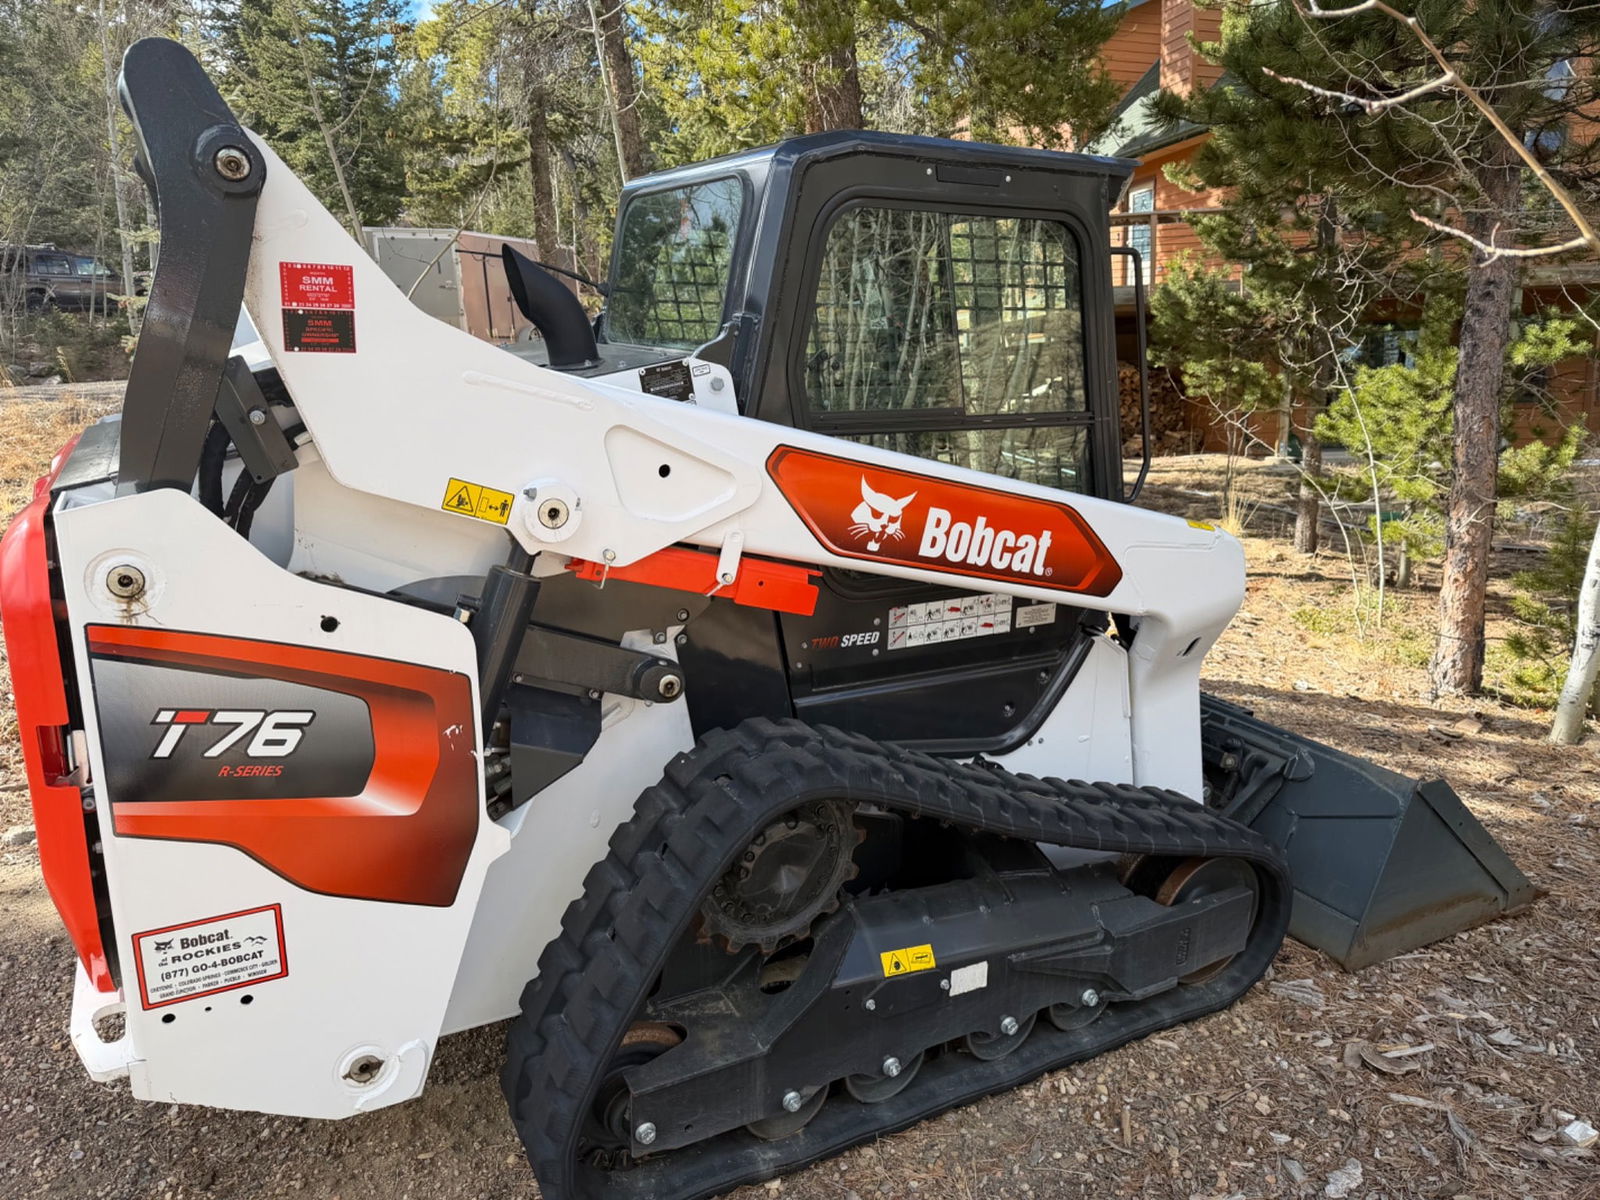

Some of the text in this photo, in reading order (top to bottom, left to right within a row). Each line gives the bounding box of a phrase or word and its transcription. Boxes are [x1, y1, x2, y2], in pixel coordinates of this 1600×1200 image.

[299, 284, 338, 293] RENTAL
[302, 275, 333, 285] SMM
[918, 506, 1052, 577] Bobcat
[811, 631, 880, 648] TWO SPEED
[151, 709, 315, 758] T76
[218, 765, 284, 777] R-SERIES
[180, 929, 230, 950] Bobcat
[171, 941, 242, 964] ROCKIES
[160, 950, 264, 982] (877) GO-4-BOBCAT
